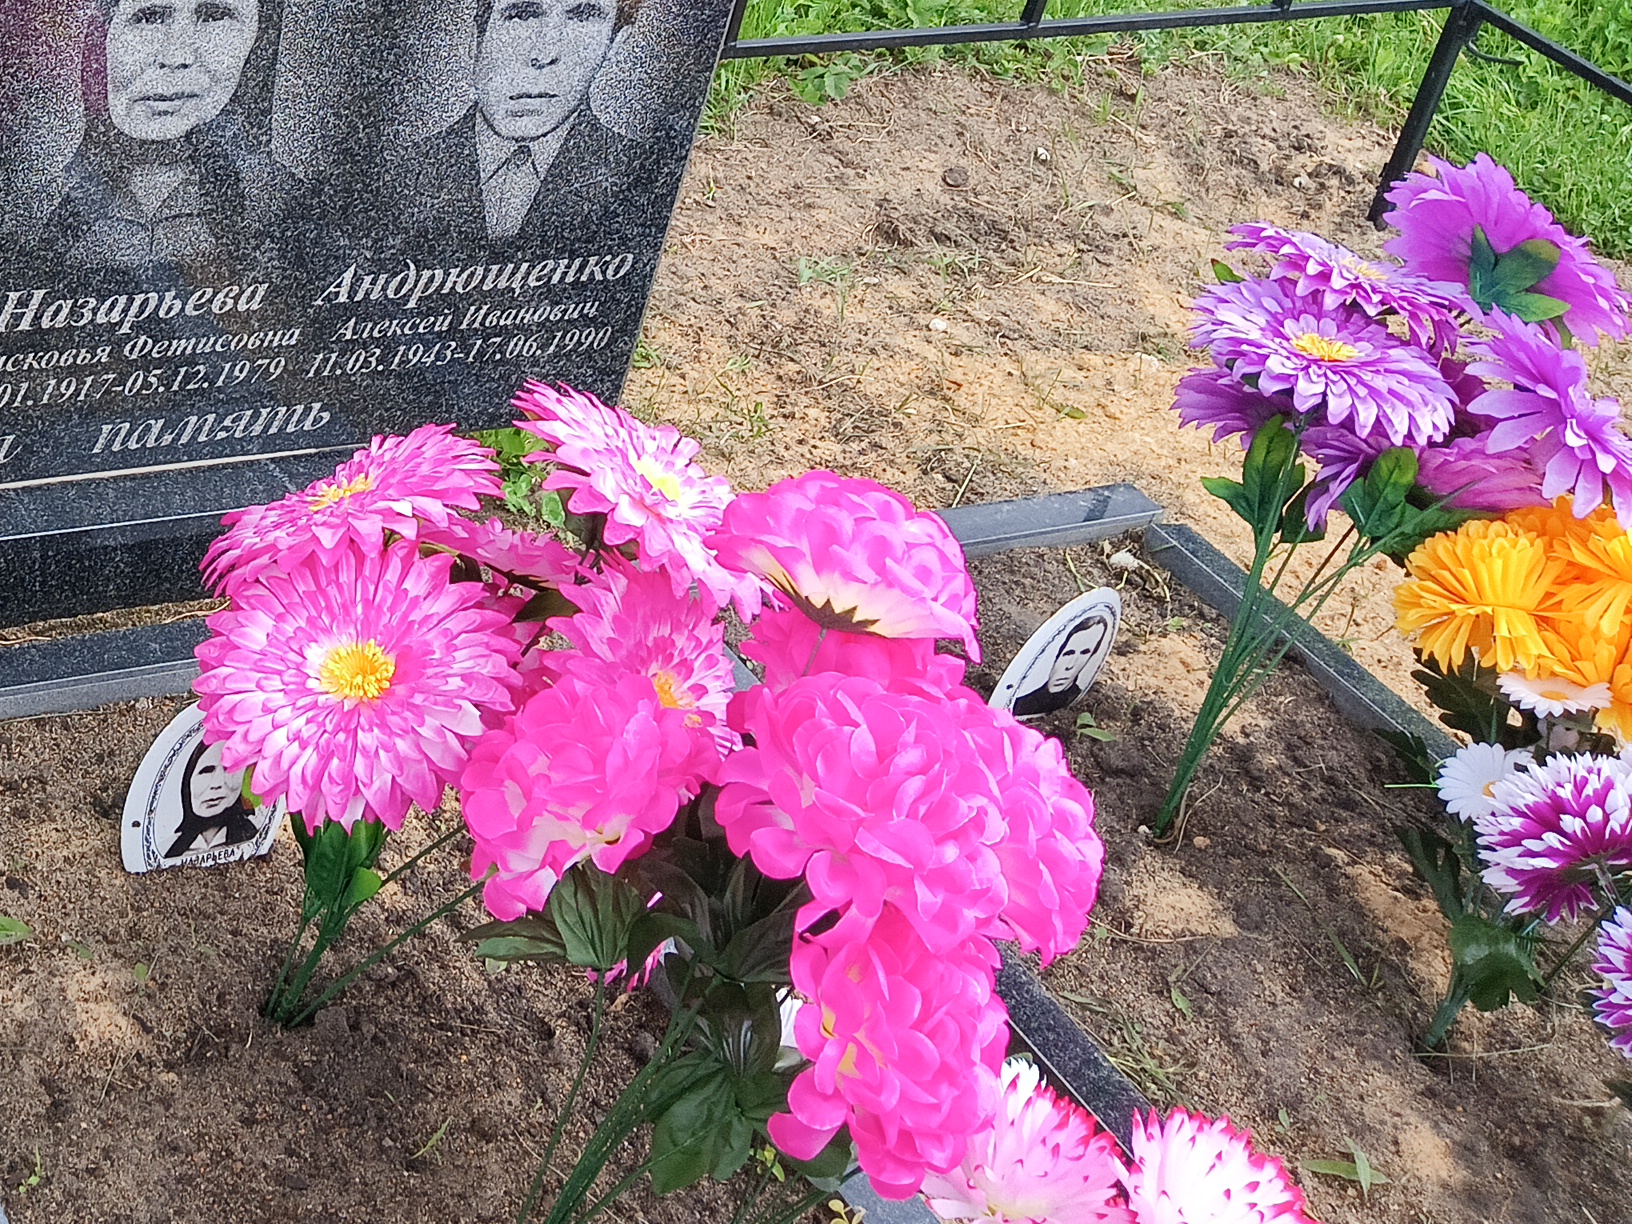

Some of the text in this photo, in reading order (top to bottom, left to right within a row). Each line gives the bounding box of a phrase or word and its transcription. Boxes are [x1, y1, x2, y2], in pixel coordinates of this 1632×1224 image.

[312, 253, 634, 309] Андрющенко
[123, 327, 301, 360] Фетисовна
[330, 300, 600, 342] Алексей Иванович
[306, 326, 612, 378] 11.03.1943-17.06.1990
[92, 402, 331, 454] память
